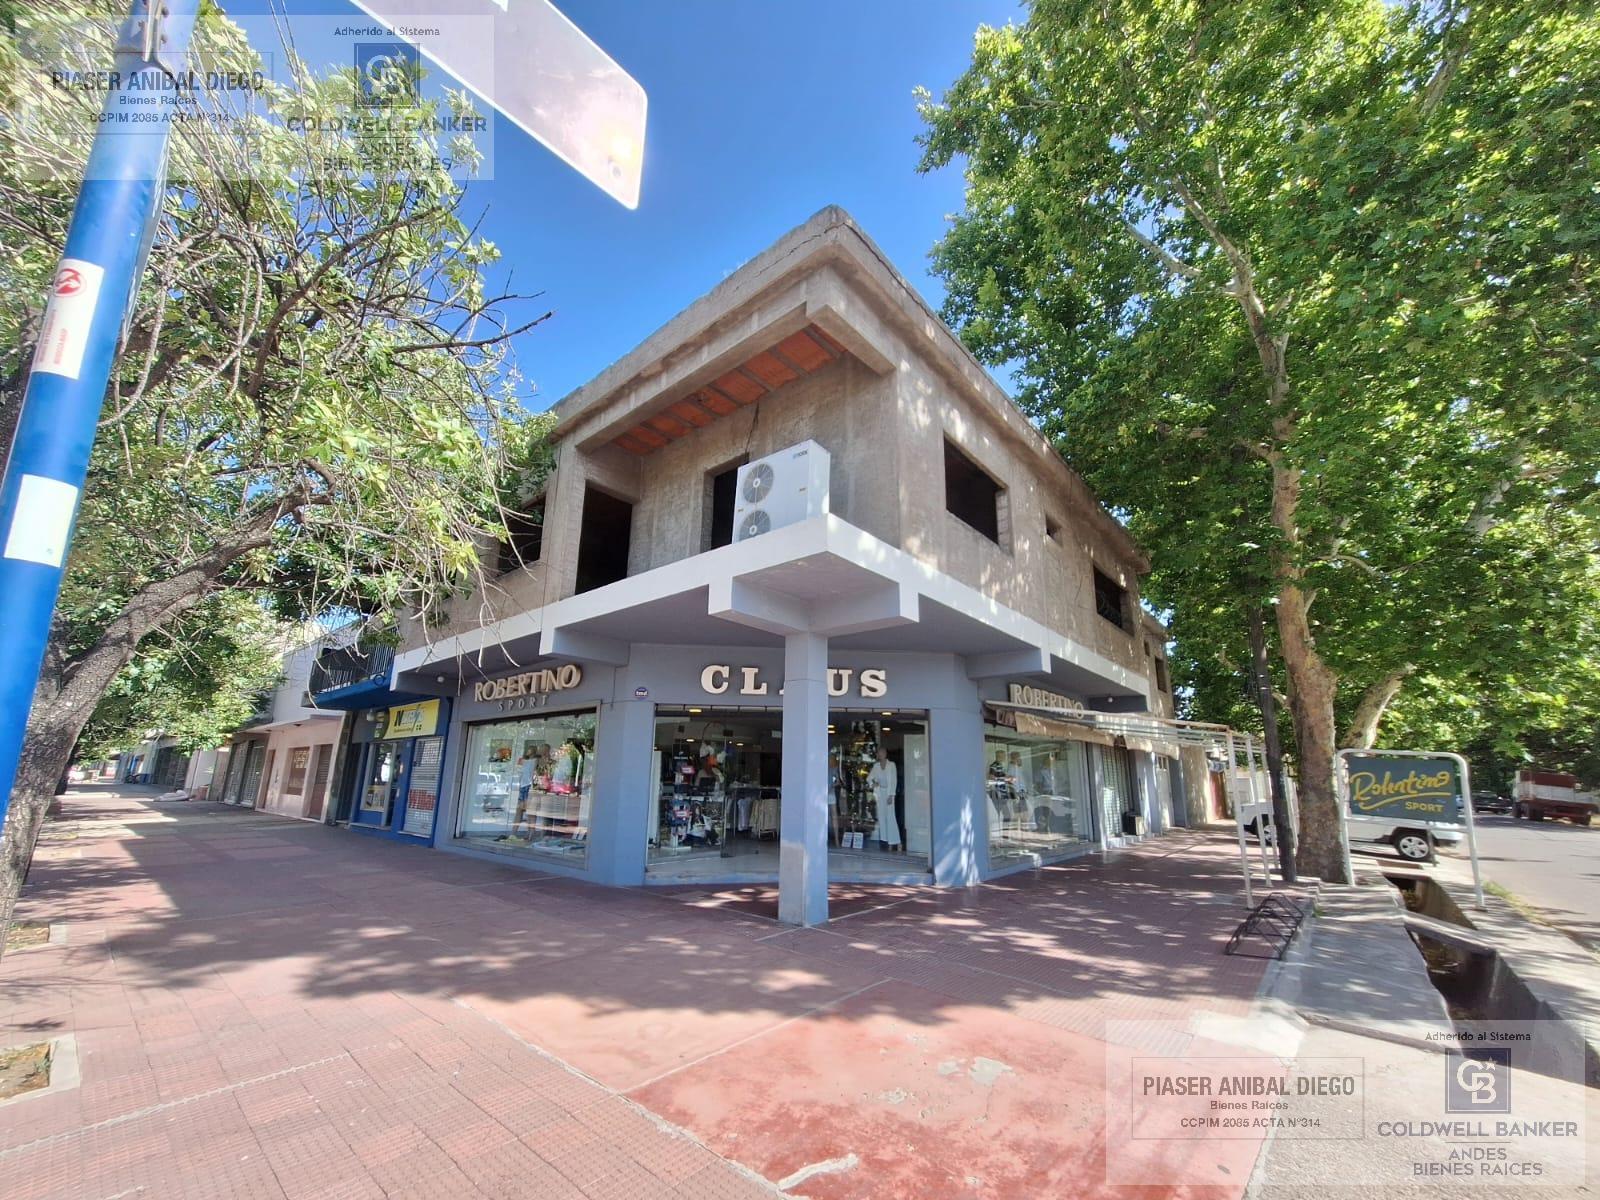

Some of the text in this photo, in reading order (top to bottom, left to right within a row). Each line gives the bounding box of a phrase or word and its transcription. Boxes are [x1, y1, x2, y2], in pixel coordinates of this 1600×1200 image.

[474, 664, 582, 702] ROBERTINO
[700, 664, 887, 698] CLUS
[498, 694, 548, 712] SPORT
[1009, 683, 1085, 719] ROBERTINO
[1405, 801, 1444, 812] SPORT
